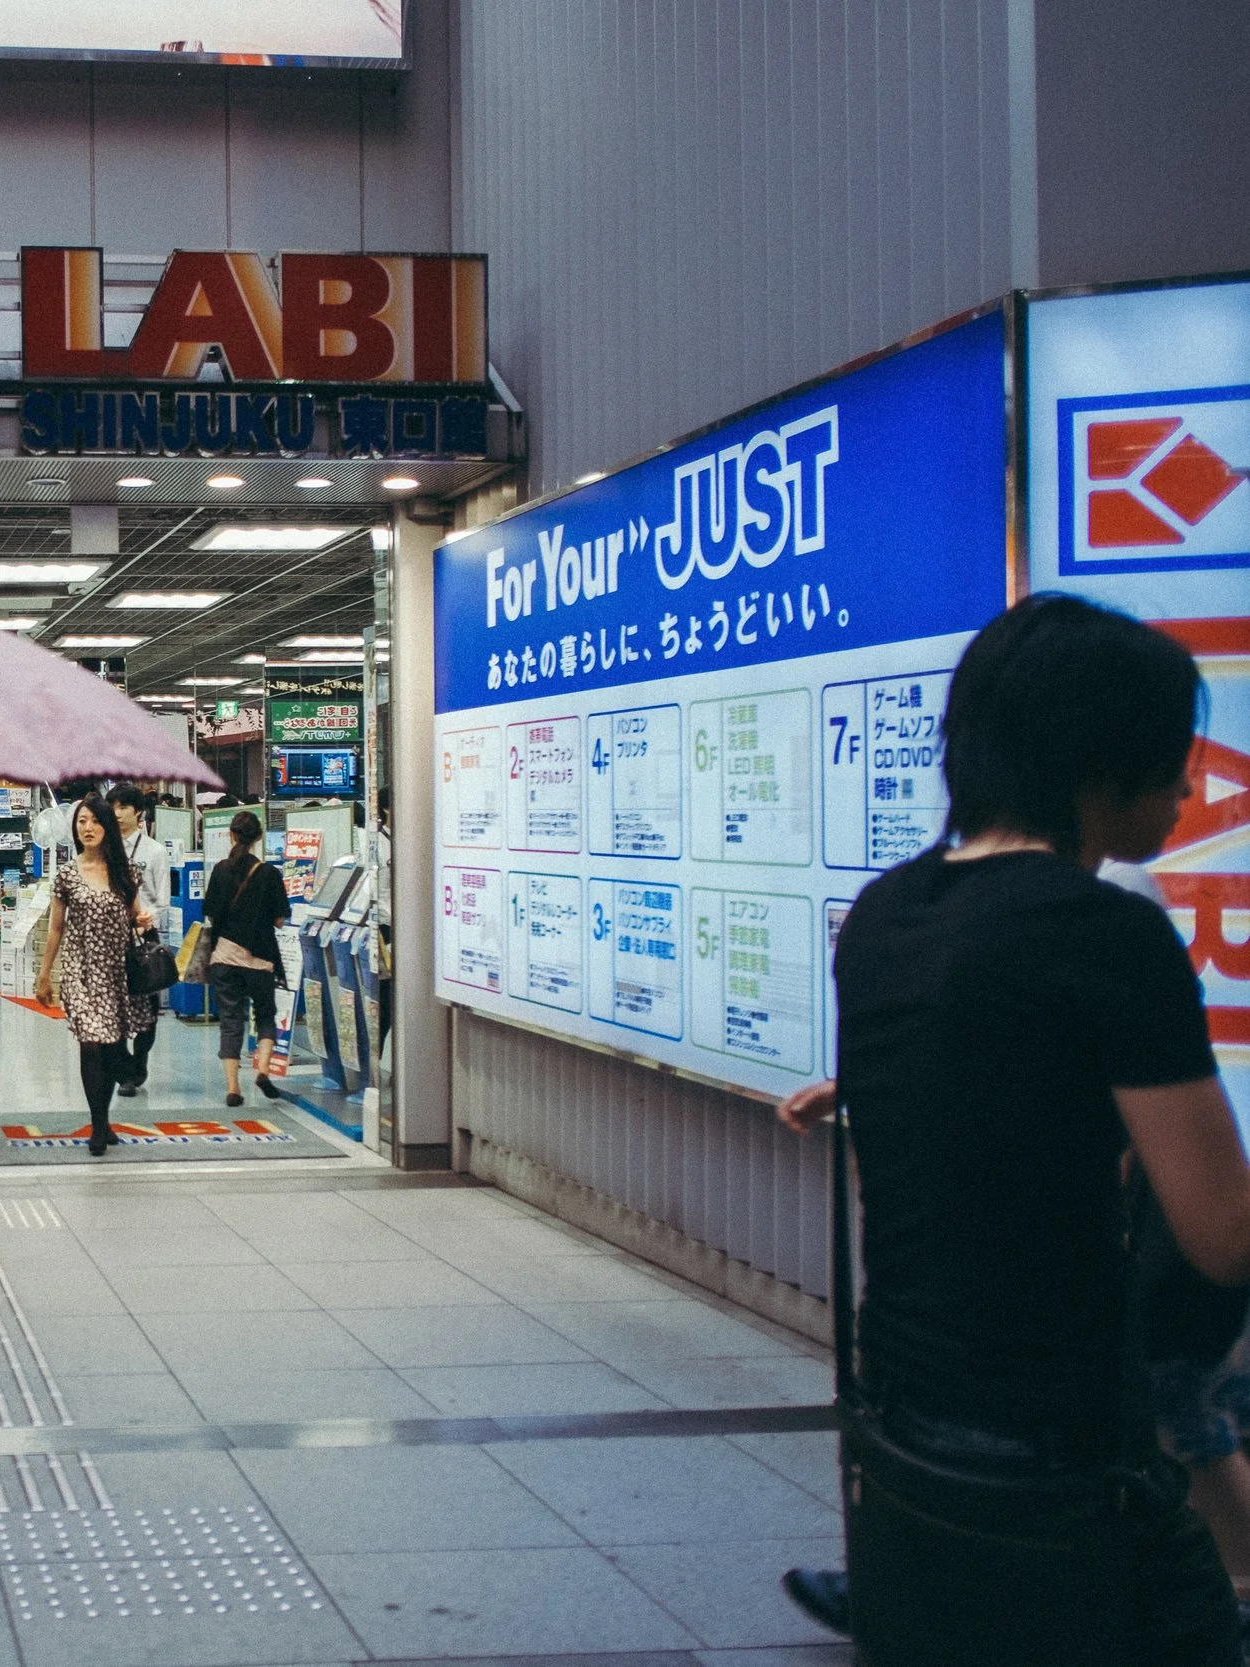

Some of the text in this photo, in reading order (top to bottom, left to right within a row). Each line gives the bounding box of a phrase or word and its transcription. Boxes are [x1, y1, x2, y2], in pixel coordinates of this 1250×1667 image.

[20, 246, 489, 384] LABI
[21, 389, 316, 457] SHINJUKU
[487, 404, 839, 629] For Your JUST
[487, 582, 850, 690] あなたの暮らしに、ちょうどいい。
[874, 684, 922, 711] ゲーム機
[617, 718, 648, 734] パソコン
[829, 715, 861, 765] 7F
[874, 715, 938, 740] ゲームソフ
[592, 738, 610, 775] 4F
[695, 729, 718, 772] 6F
[593, 903, 611, 941] 3F
[697, 915, 720, 960] 5F
[7, 1135, 191, 1149] SHINUKU
